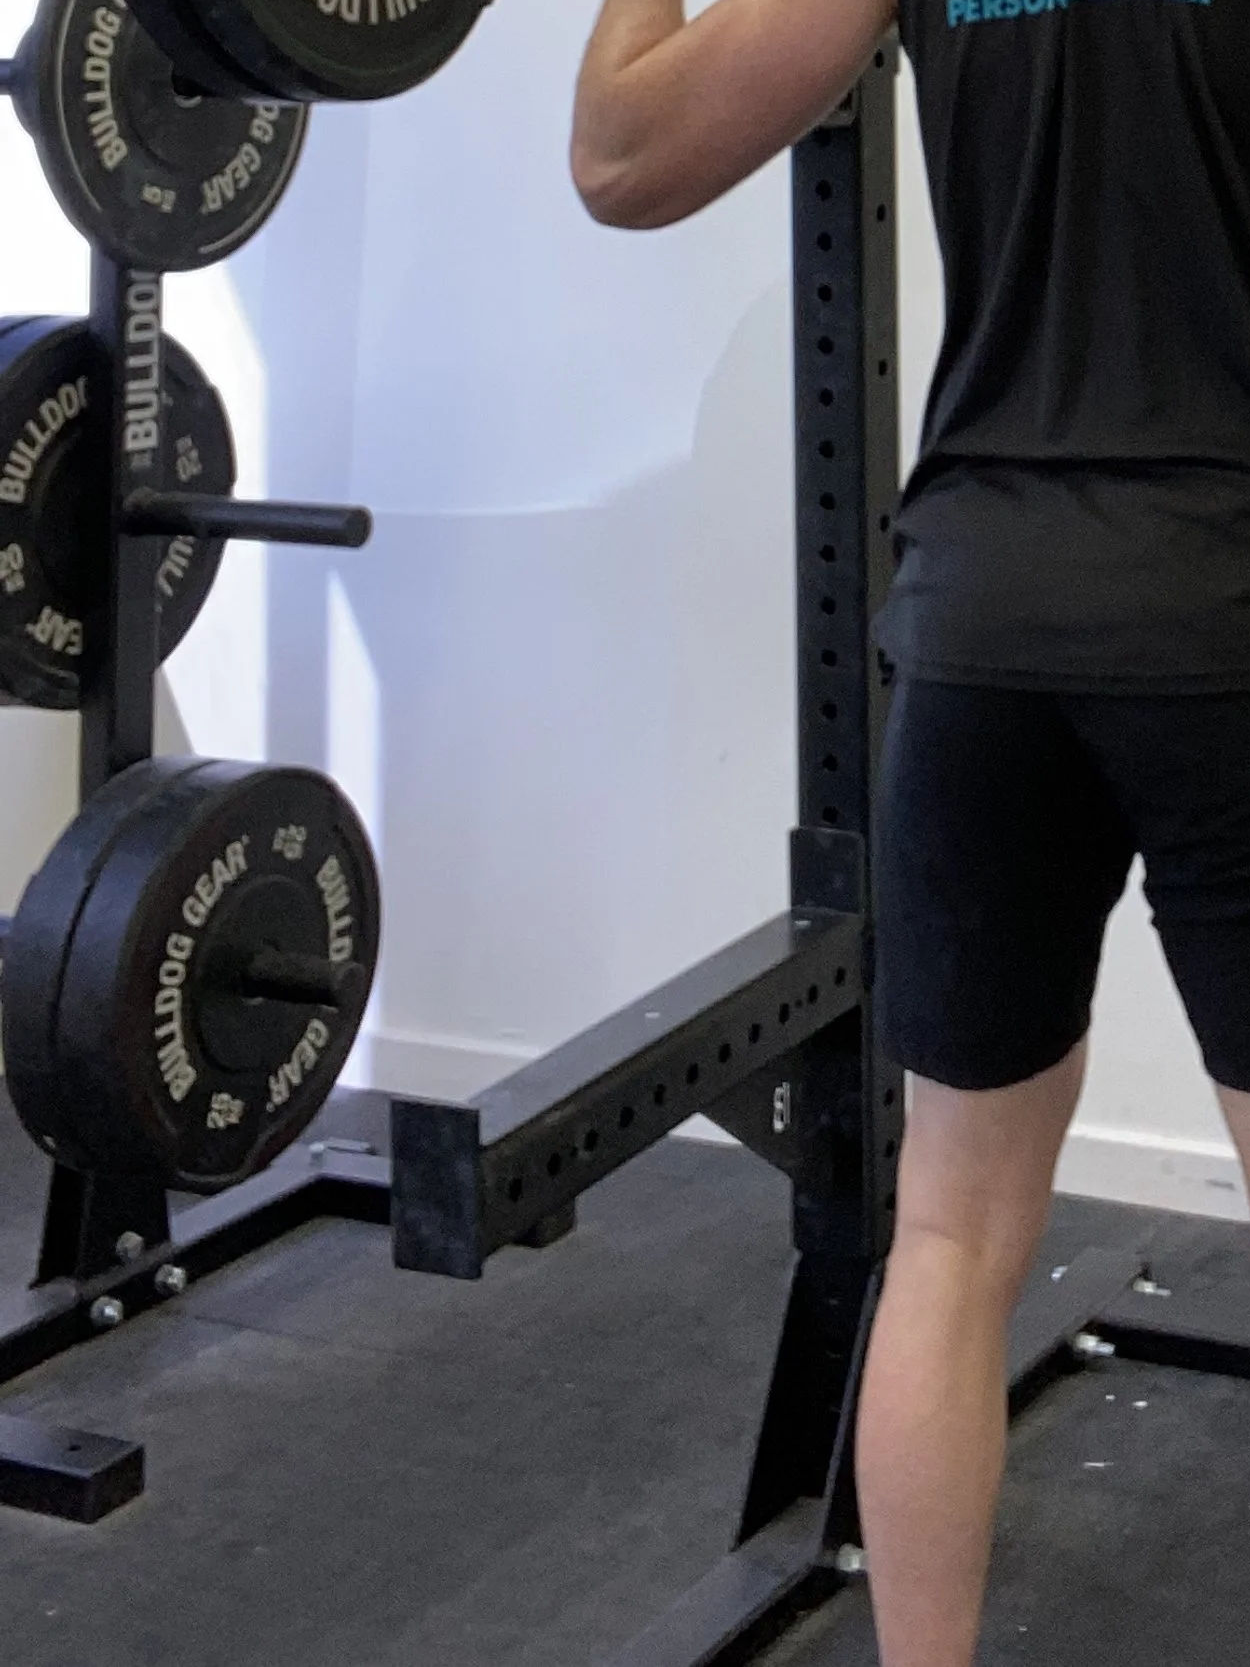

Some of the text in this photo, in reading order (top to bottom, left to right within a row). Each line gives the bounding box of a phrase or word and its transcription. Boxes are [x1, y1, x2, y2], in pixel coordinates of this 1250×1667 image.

[83, 5, 129, 171] BULLDOG
[202, 141, 262, 213] GEAR
[32, 605, 84, 656] EAR
[315, 854, 354, 963] BULLD
[154, 839, 249, 1102] BULLDOG GEAR
[269, 1017, 329, 1107] GEAR
